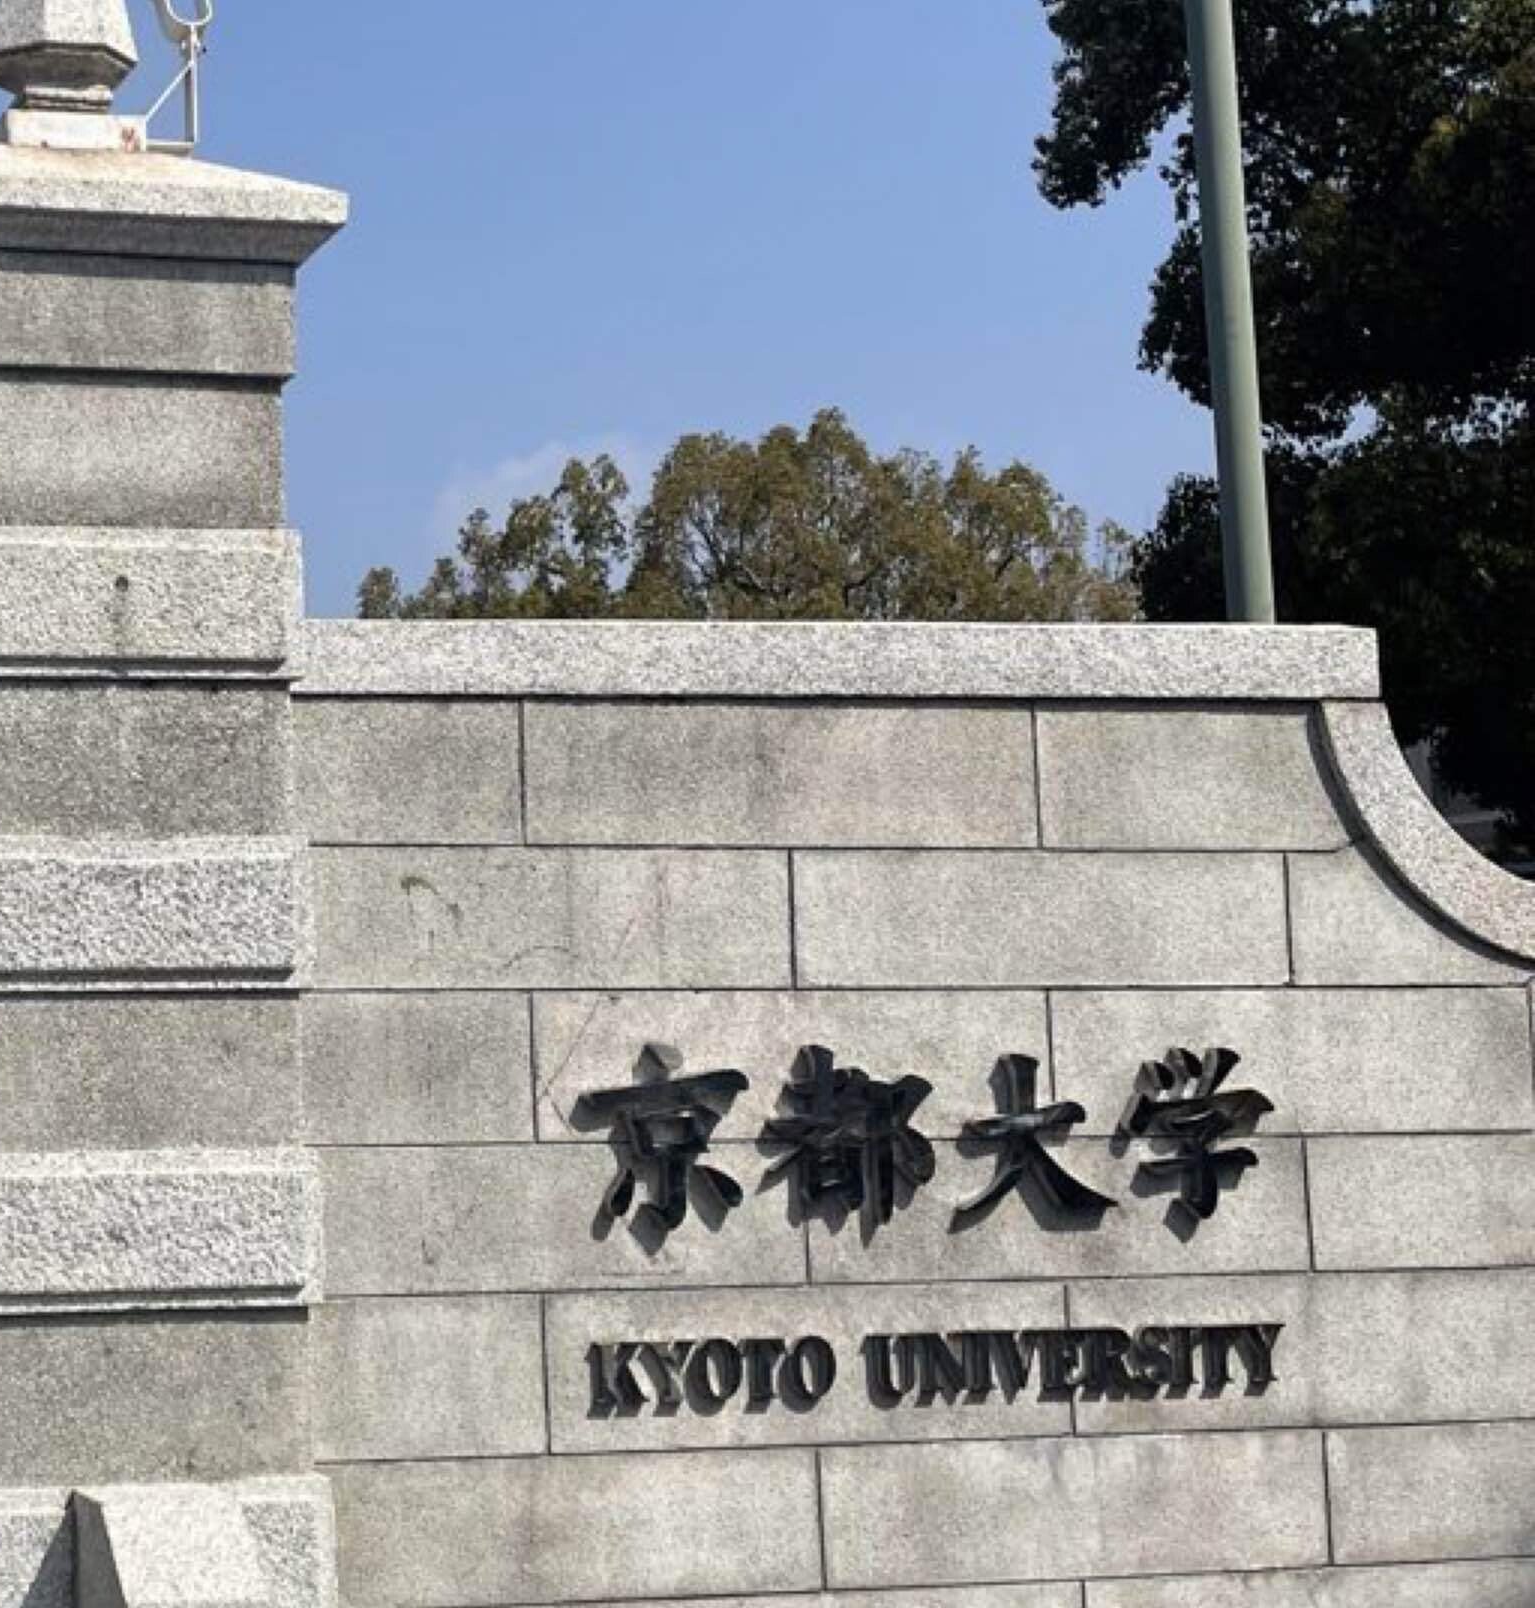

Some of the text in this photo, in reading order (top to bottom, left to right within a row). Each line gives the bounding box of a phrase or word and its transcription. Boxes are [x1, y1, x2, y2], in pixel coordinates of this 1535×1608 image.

[570, 1044, 1274, 1254] 京都大学
[586, 1323, 1285, 1417] KYOTO UNIVERSITY
